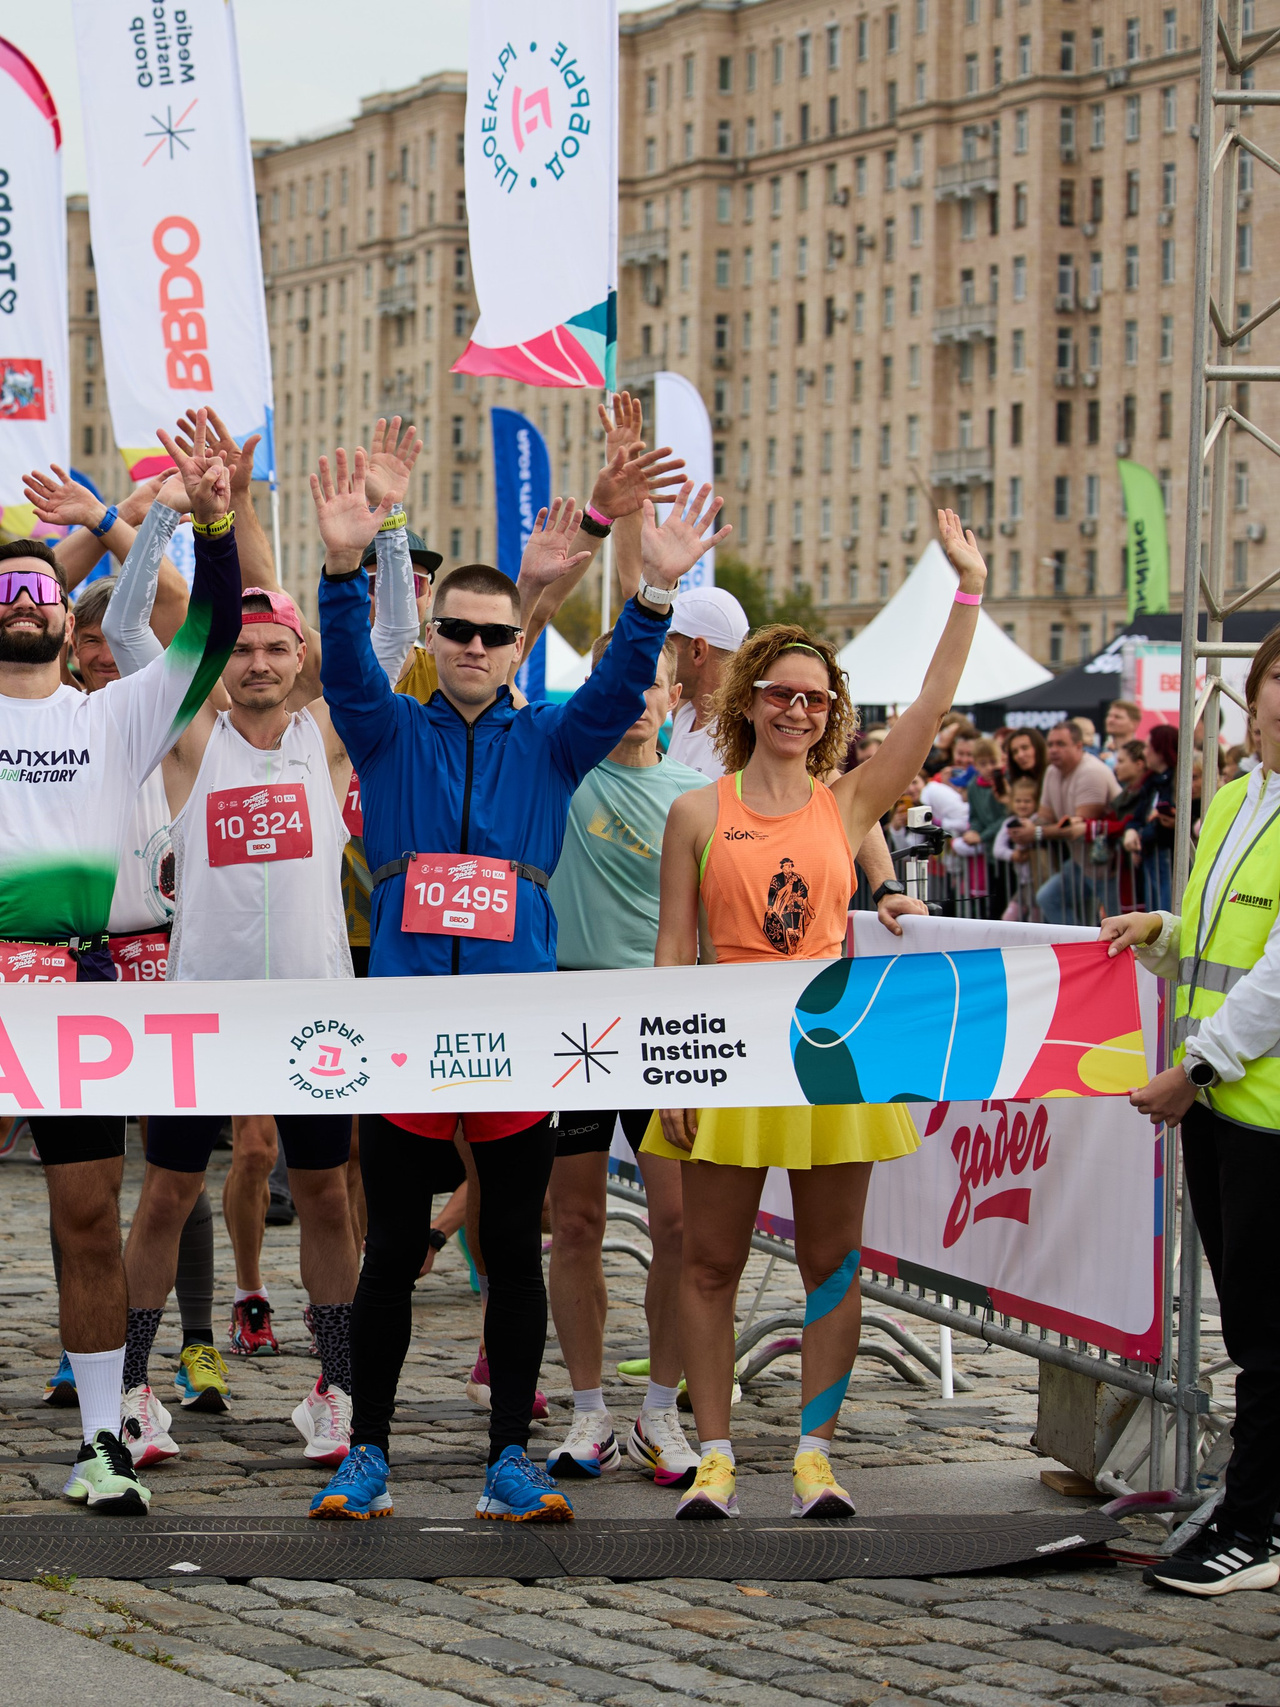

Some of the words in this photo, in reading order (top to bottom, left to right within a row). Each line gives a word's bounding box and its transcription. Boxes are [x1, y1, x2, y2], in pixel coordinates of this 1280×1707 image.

[273, 795, 283, 803] 10
[214, 816, 245, 840] 10
[252, 811, 304, 836] 324
[252, 843, 271, 851] BBDO
[481, 869, 492, 878] 10
[413, 882, 445, 907] 10
[451, 885, 508, 913] 495
[448, 916, 469, 924] BBDO
[146, 944, 155, 952] 10
[40, 957, 51, 966] 10
[128, 958, 168, 981] 199
[288, 1019, 366, 1052] ДОБРЫЕ
[639, 1013, 727, 1037] Media
[433, 1032, 507, 1059] ДЕТИ
[641, 1037, 747, 1062] Instinct
[430, 1057, 512, 1080] НАШИ
[642, 1065, 728, 1087] Group
[288, 1071, 372, 1100] ПРОЕКТЫ
